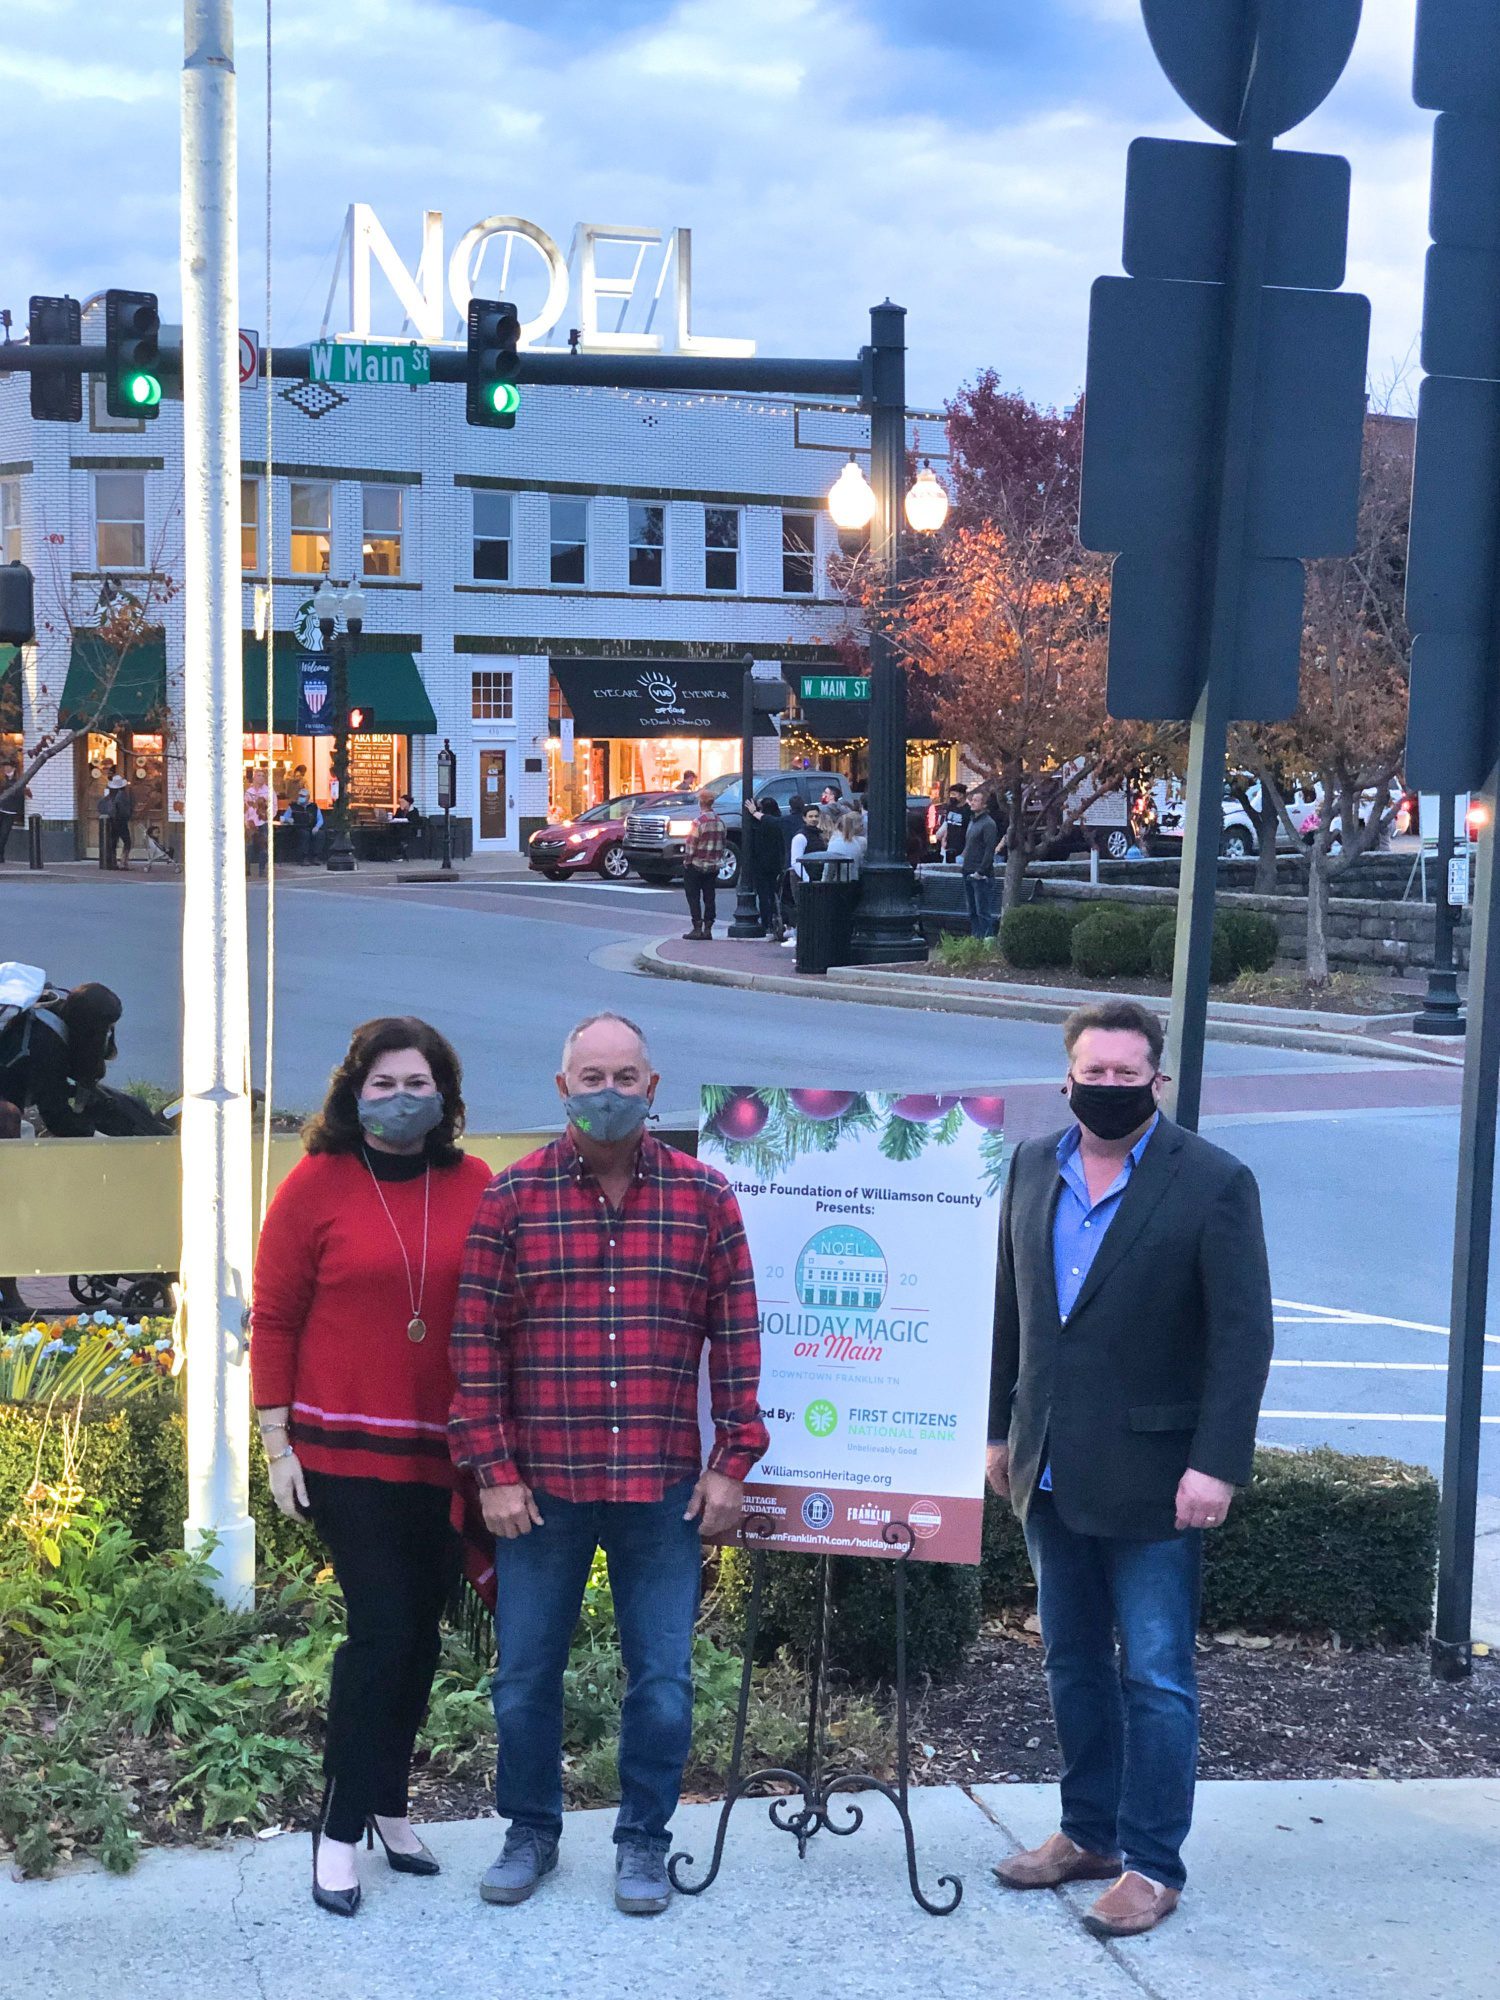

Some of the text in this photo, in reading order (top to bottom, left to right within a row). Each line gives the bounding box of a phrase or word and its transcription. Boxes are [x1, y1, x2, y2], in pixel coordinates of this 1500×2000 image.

[350, 203, 756, 354] NOEL
[311, 345, 429, 381] W Main St
[302, 661, 330, 673] Welcome
[593, 689, 642, 698] EYECARE
[682, 690, 730, 699] EYEWEAR
[804, 680, 867, 697] W MAIN ST
[730, 1181, 982, 1208] ritage Foundation of Williamson County
[816, 1201, 875, 1215] Presents:
[821, 1241, 864, 1256] NOEL
[766, 1266, 785, 1279] 20
[900, 1273, 918, 1286] 20
[855, 1318, 929, 1344] MAGIC
[793, 1334, 883, 1361] on Main
[772, 1369, 900, 1385] DOWNTOWN FRANKLIN TN
[777, 1408, 795, 1422] By:
[849, 1408, 957, 1427] FIRST CITIZENS
[848, 1424, 956, 1441] NATIONAL BANK
[847, 1443, 918, 1456] Unbelievably Good
[761, 1465, 892, 1486] WilliamsonHeritage.org
[743, 1495, 777, 1506] RITAGE
[741, 1504, 788, 1515] UNDATION
[847, 1507, 891, 1524] FRANKLIN
